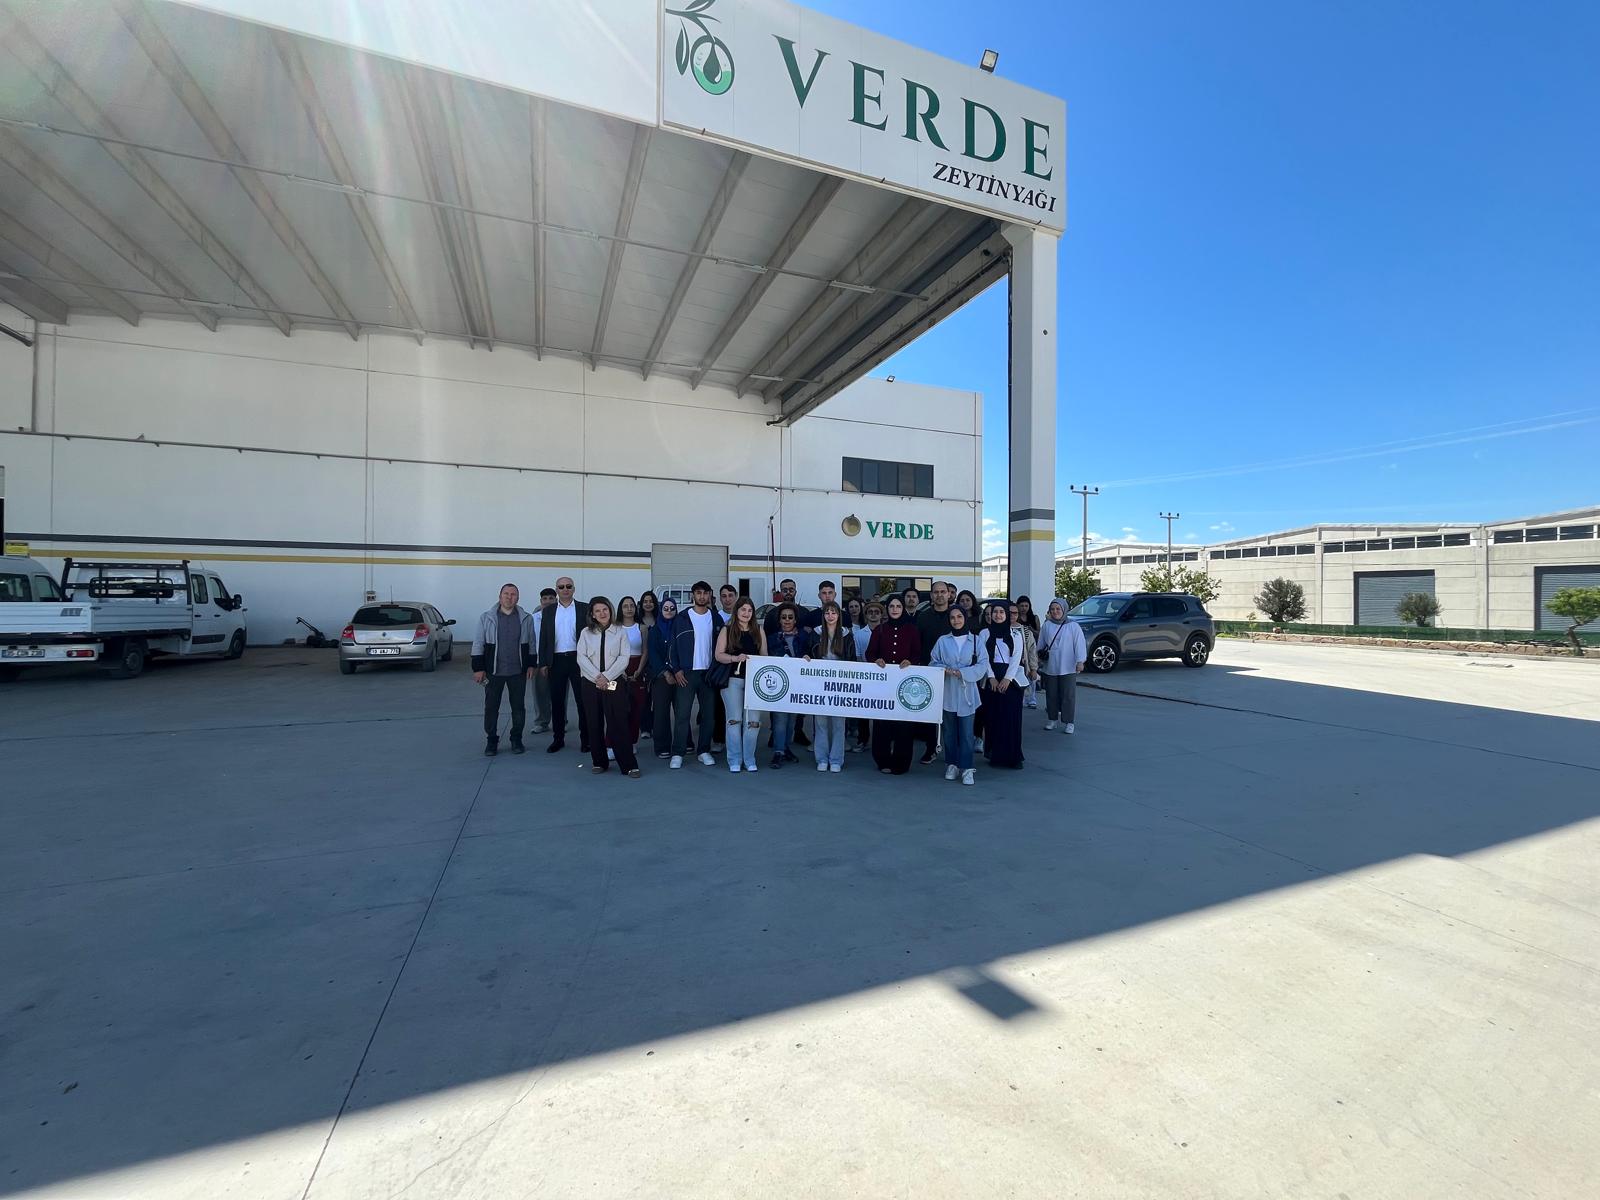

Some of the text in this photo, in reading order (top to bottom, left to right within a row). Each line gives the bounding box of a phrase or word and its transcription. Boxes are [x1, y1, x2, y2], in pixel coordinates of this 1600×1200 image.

[771, 33, 1053, 181] VERDE
[933, 162, 1057, 212] ZEYTİNYAĞI
[866, 521, 934, 540] VERDE
[800, 667, 888, 681] BALIKESİR ÜNİVERSİTESİ
[824, 681, 862, 694] HAVRAN
[790, 693, 895, 710] MESLEK YÜKSEKOKULU
